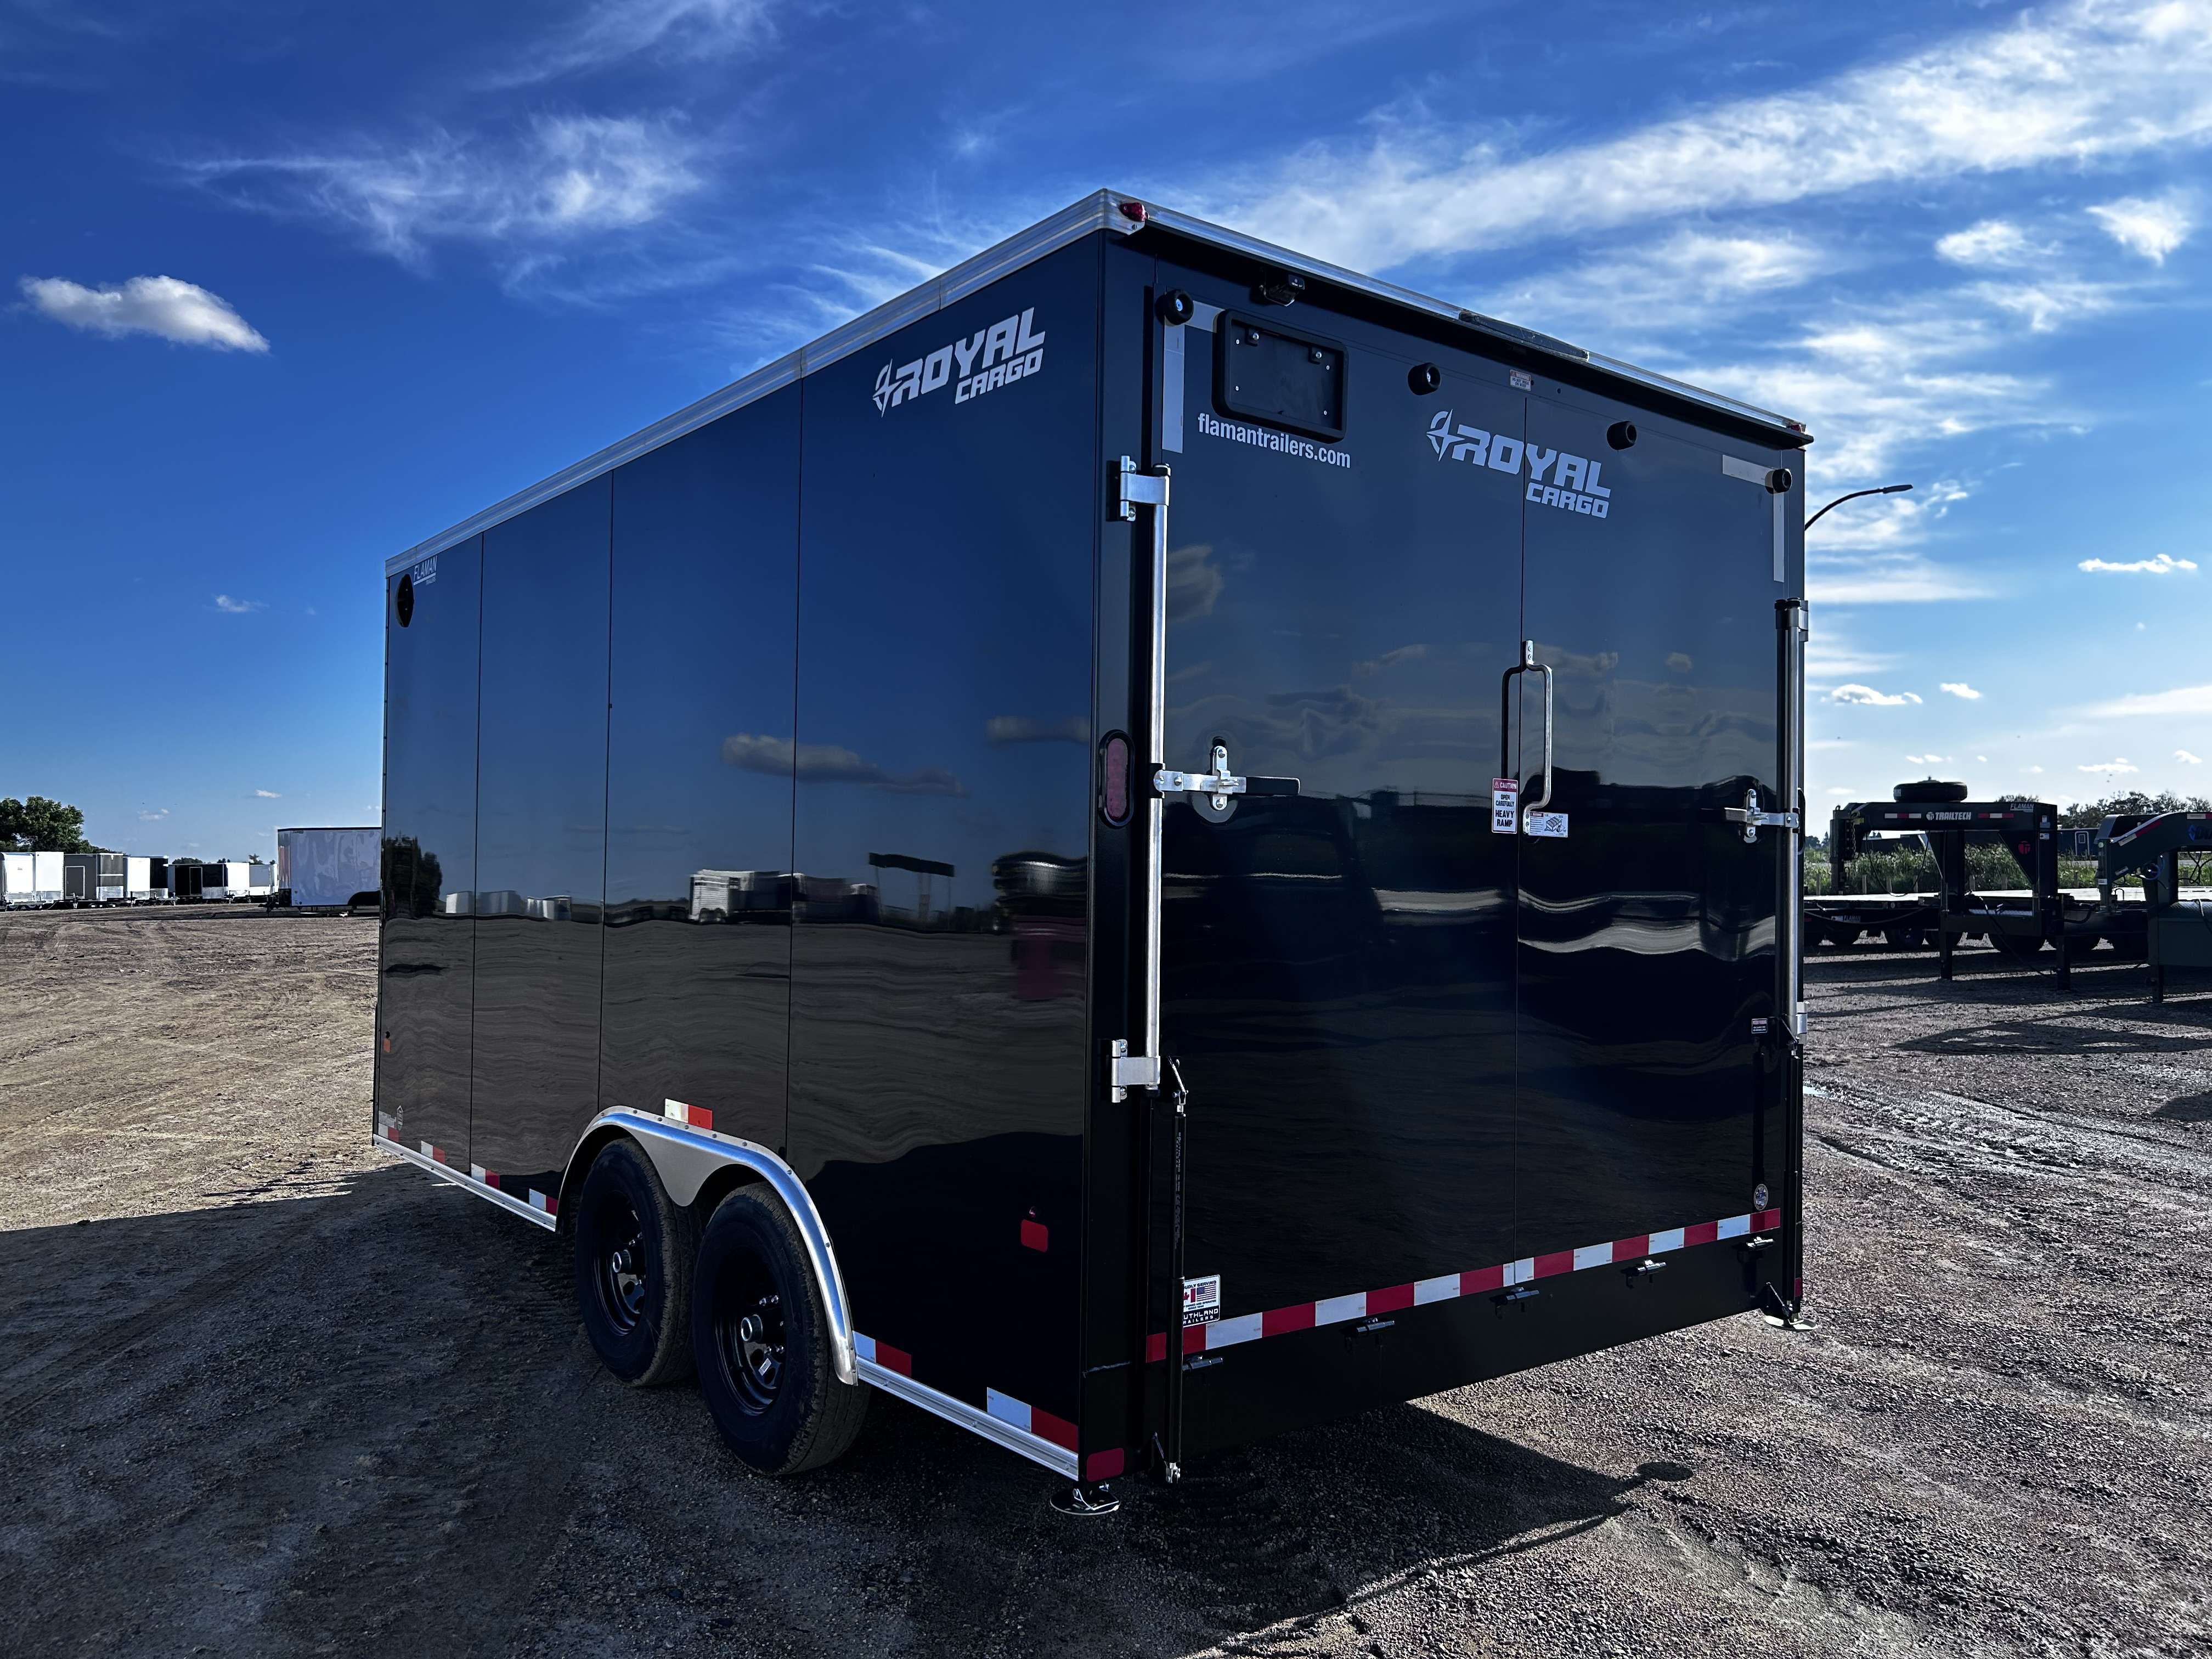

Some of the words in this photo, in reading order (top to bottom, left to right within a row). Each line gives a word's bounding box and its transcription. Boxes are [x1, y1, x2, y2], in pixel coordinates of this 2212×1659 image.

[891, 307, 1045, 408] ROYAL
[955, 348, 1043, 405] CARGO
[1198, 413, 1351, 468] flamantrailers.com
[1451, 424, 1611, 498] ROYAL
[1526, 482, 1609, 518] CARGO
[414, 555, 437, 581] FLAMAN
[1495, 809, 1514, 818] HEAVY
[1497, 819, 1513, 827] RAMP
[1935, 811, 1972, 820] TRAILTECH
[1183, 1315, 1214, 1324] RAILERS
[1184, 1308, 1218, 1319] UTHLAND
